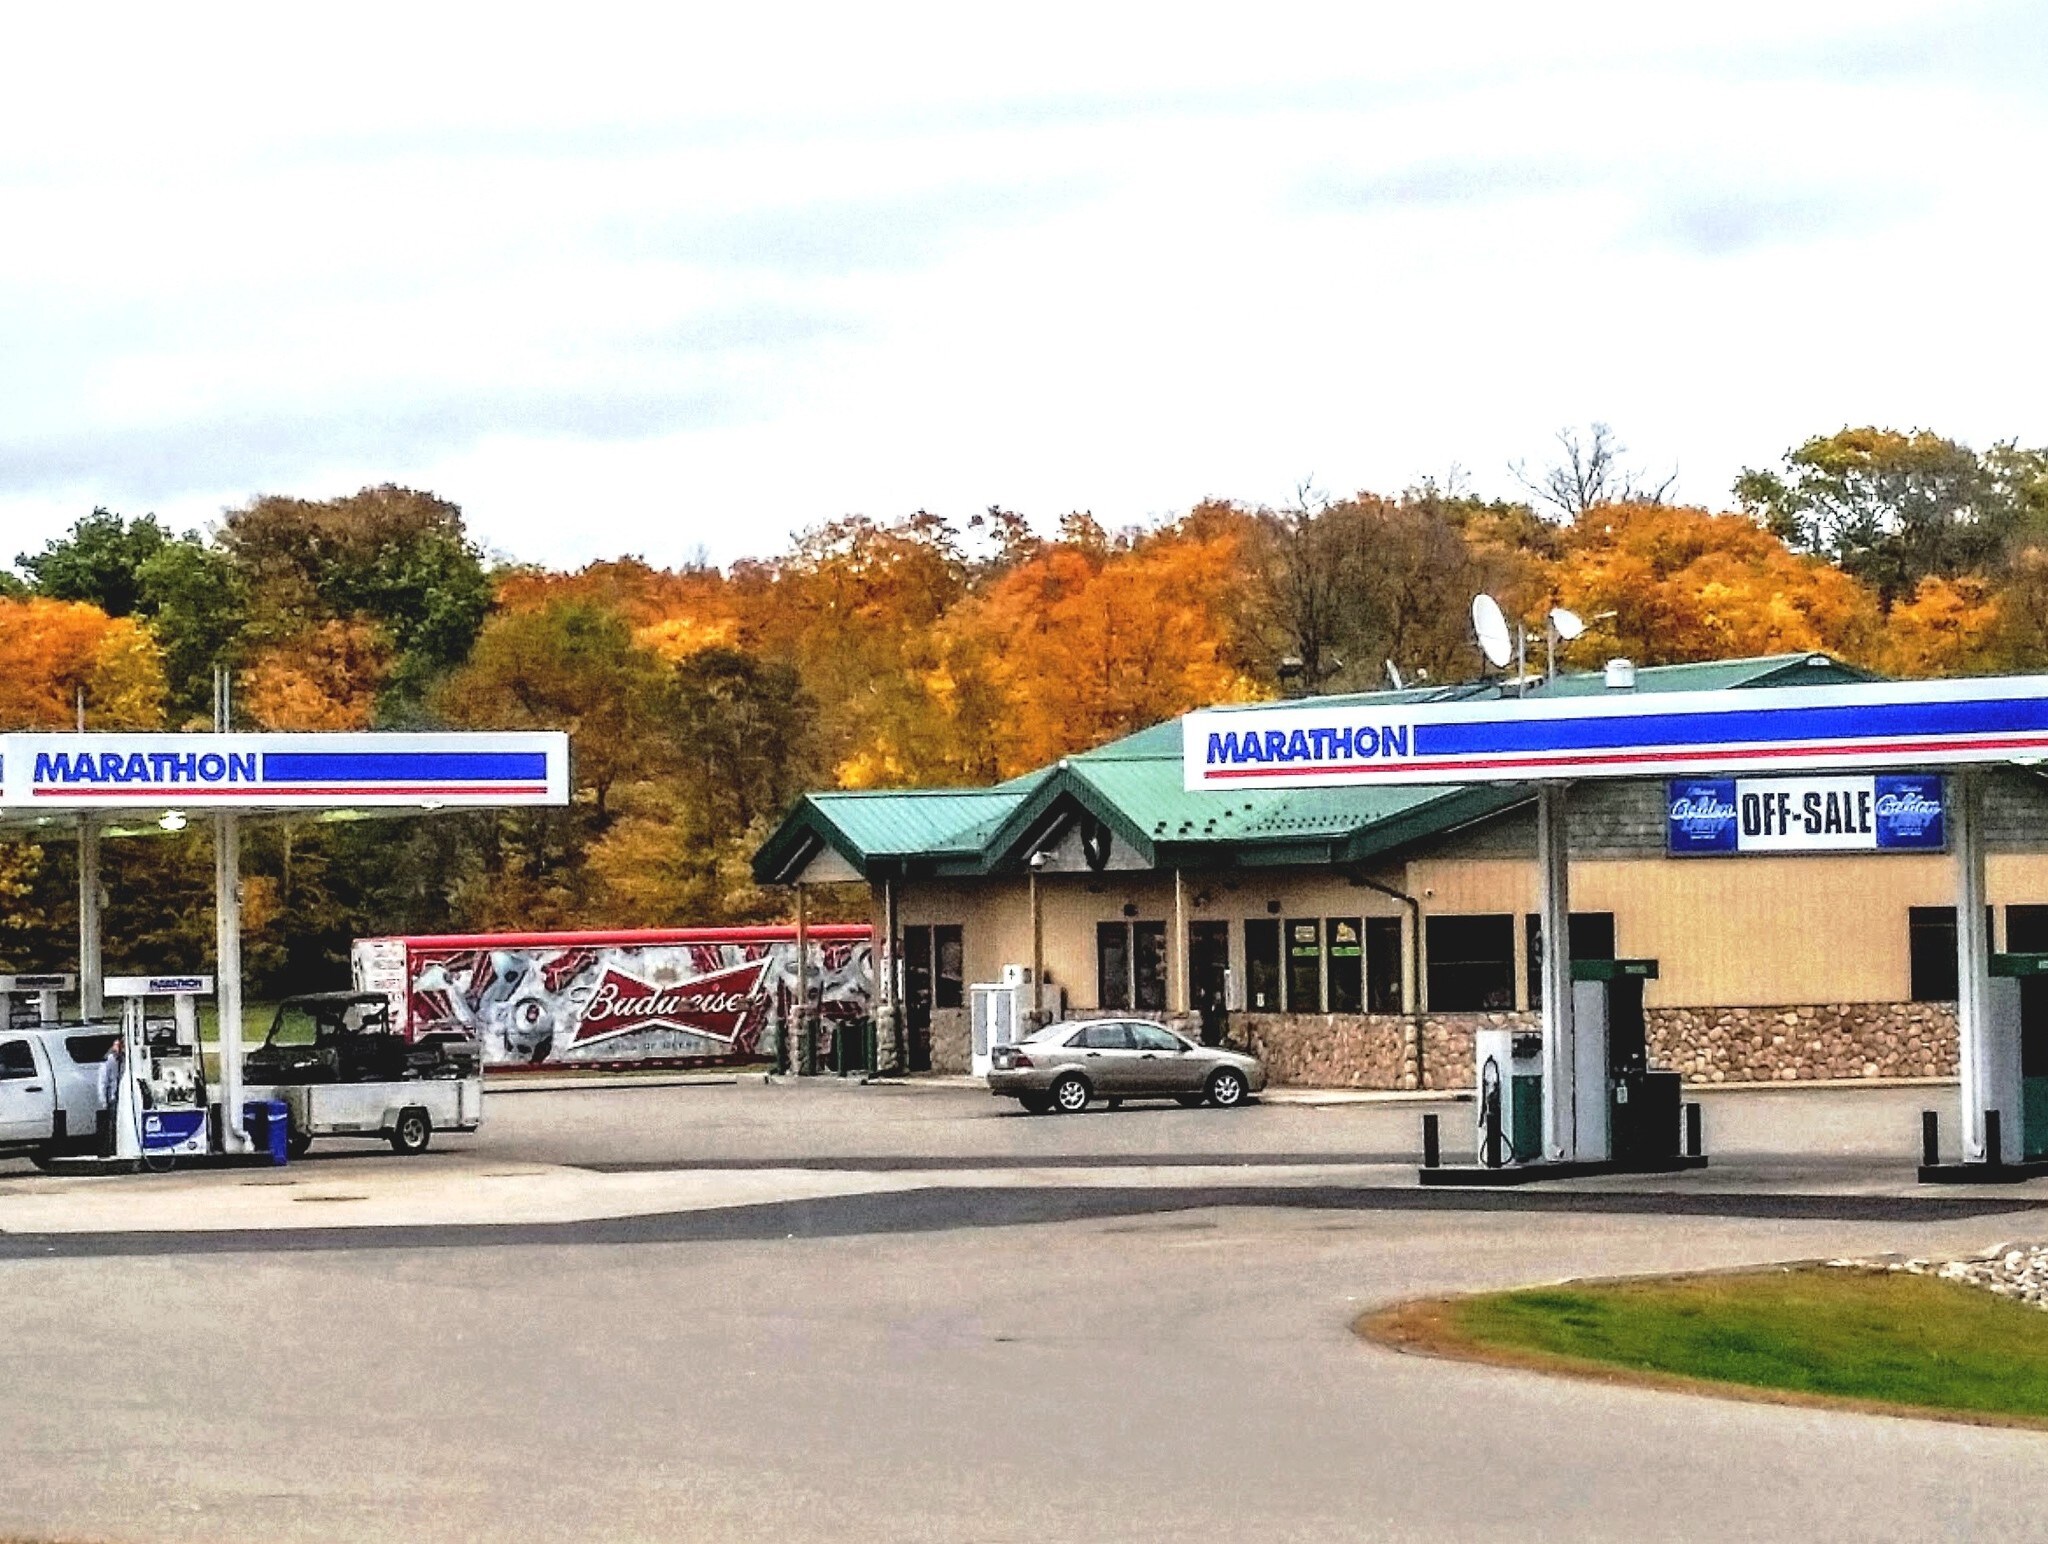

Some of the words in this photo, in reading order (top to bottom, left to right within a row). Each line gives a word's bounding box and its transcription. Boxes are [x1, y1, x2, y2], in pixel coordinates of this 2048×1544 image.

[1206, 724, 1408, 764] MARATHON
[34, 752, 257, 783] MARATHON
[1742, 790, 1872, 836] OFF-SALE
[149, 978, 202, 988] MTHON
